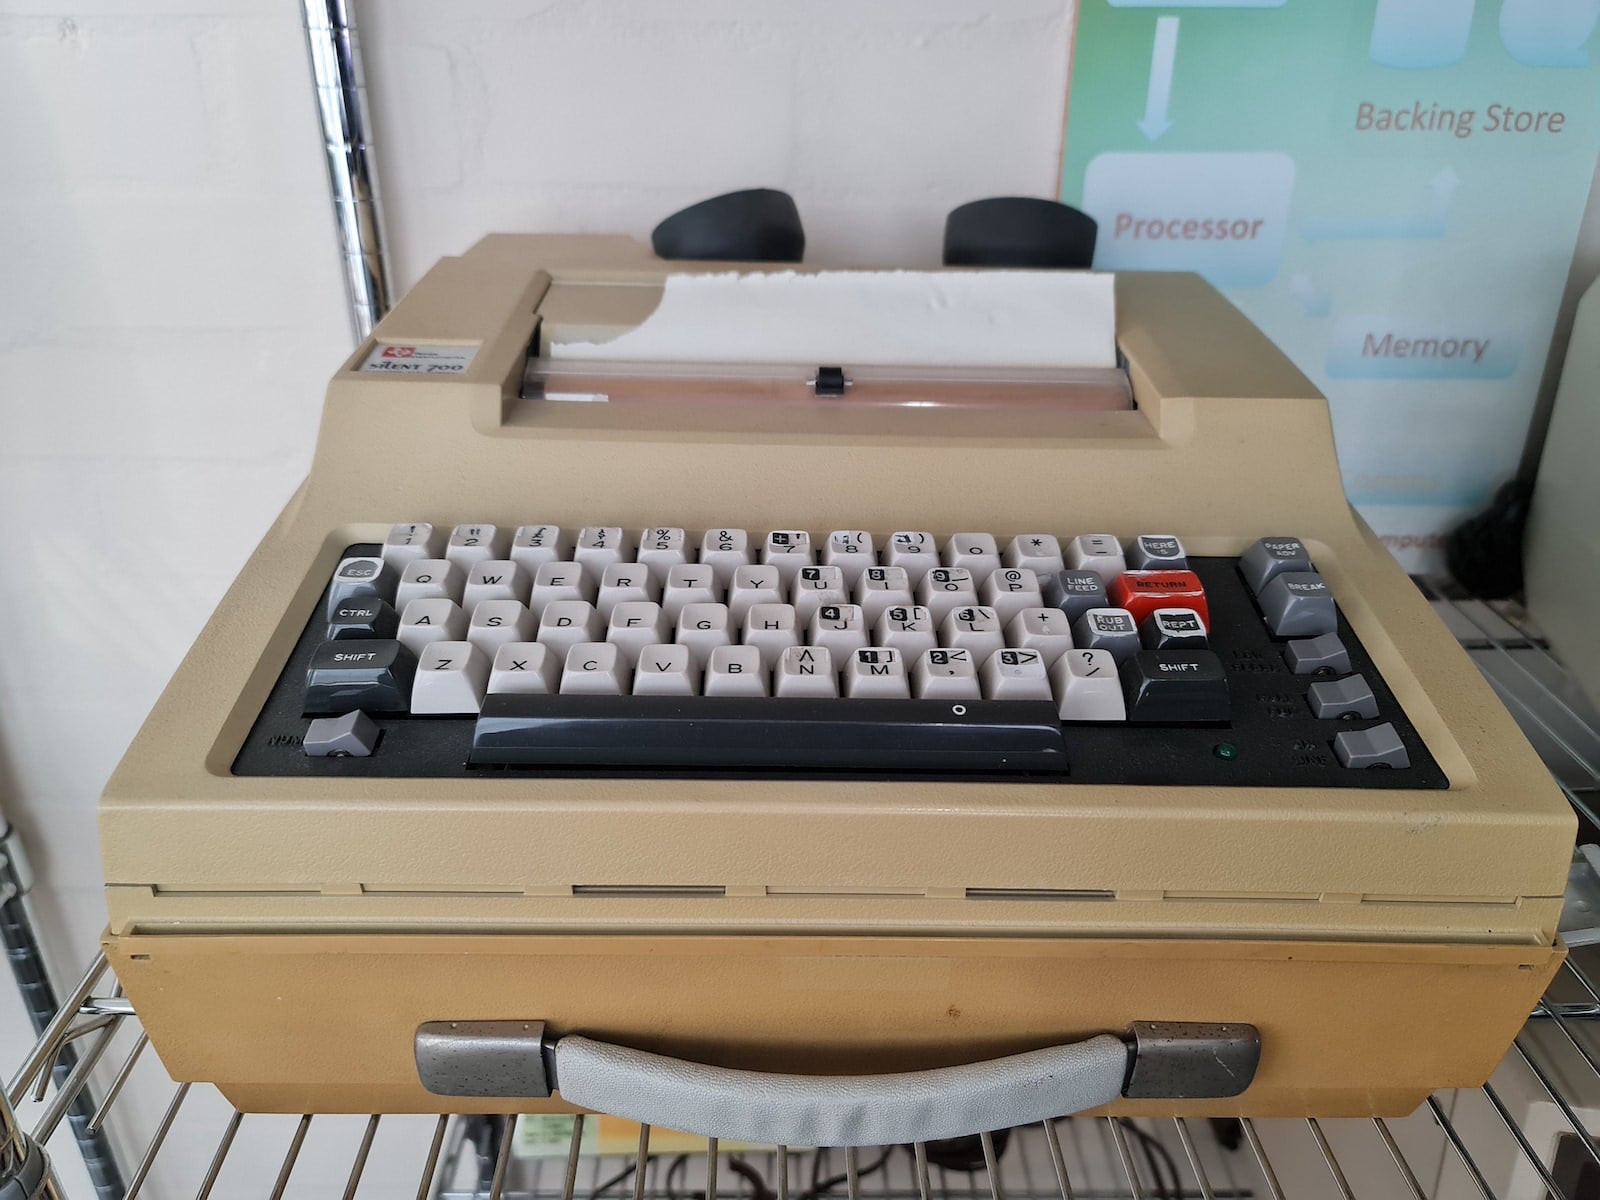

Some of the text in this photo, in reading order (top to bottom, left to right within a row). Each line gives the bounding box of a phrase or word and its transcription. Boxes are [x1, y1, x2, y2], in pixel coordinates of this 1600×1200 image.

[1356, 101, 1566, 138] Backing Store
[1114, 212, 1264, 240] Processor
[1361, 332, 1490, 364] Memory
[427, 364, 464, 372] 700
[531, 527, 546, 540] £
[598, 528, 606, 540] $
[656, 529, 671, 541] %
[719, 530, 733, 542] &
[463, 538, 479, 547] 2
[529, 539, 542, 548] 3
[592, 541, 606, 549] 4
[655, 542, 669, 550] 5
[719, 543, 733, 551] 6
[1144, 541, 1176, 551] HERE
[1265, 542, 1300, 551] PAPER
[783, 545, 796, 553] 7
[845, 545, 859, 553] 8
[907, 545, 921, 553] 9
[416, 574, 432, 584] Q
[482, 575, 503, 584] W
[1004, 570, 1022, 582] @
[550, 577, 565, 586] E
[616, 578, 632, 587] R
[683, 579, 698, 588] T
[750, 580, 764, 588] Y
[814, 581, 828, 589] U
[1067, 577, 1095, 586] LINE
[1136, 581, 1187, 589] RETURN
[1009, 583, 1023, 591] P
[1287, 583, 1326, 591] BREAK
[339, 609, 373, 617] CTRL
[415, 615, 431, 625] A
[486, 617, 503, 627] S
[557, 618, 572, 627] D
[627, 618, 642, 627] F
[1097, 616, 1124, 625] RUB
[1162, 619, 1196, 629] REPT
[696, 621, 711, 630] G
[765, 621, 779, 630] H
[833, 620, 848, 630] J
[902, 622, 917, 631] K
[969, 622, 985, 632] L
[1099, 623, 1126, 631] OUT
[334, 653, 377, 662] SHIFT
[1082, 652, 1094, 666] ?
[435, 659, 452, 670] Z
[509, 660, 528, 671] X
[583, 661, 598, 671] C
[655, 662, 672, 672] V
[728, 663, 743, 674] B
[1159, 663, 1199, 672] SHIFT
[800, 664, 814, 675] N
[870, 665, 889, 675] M
